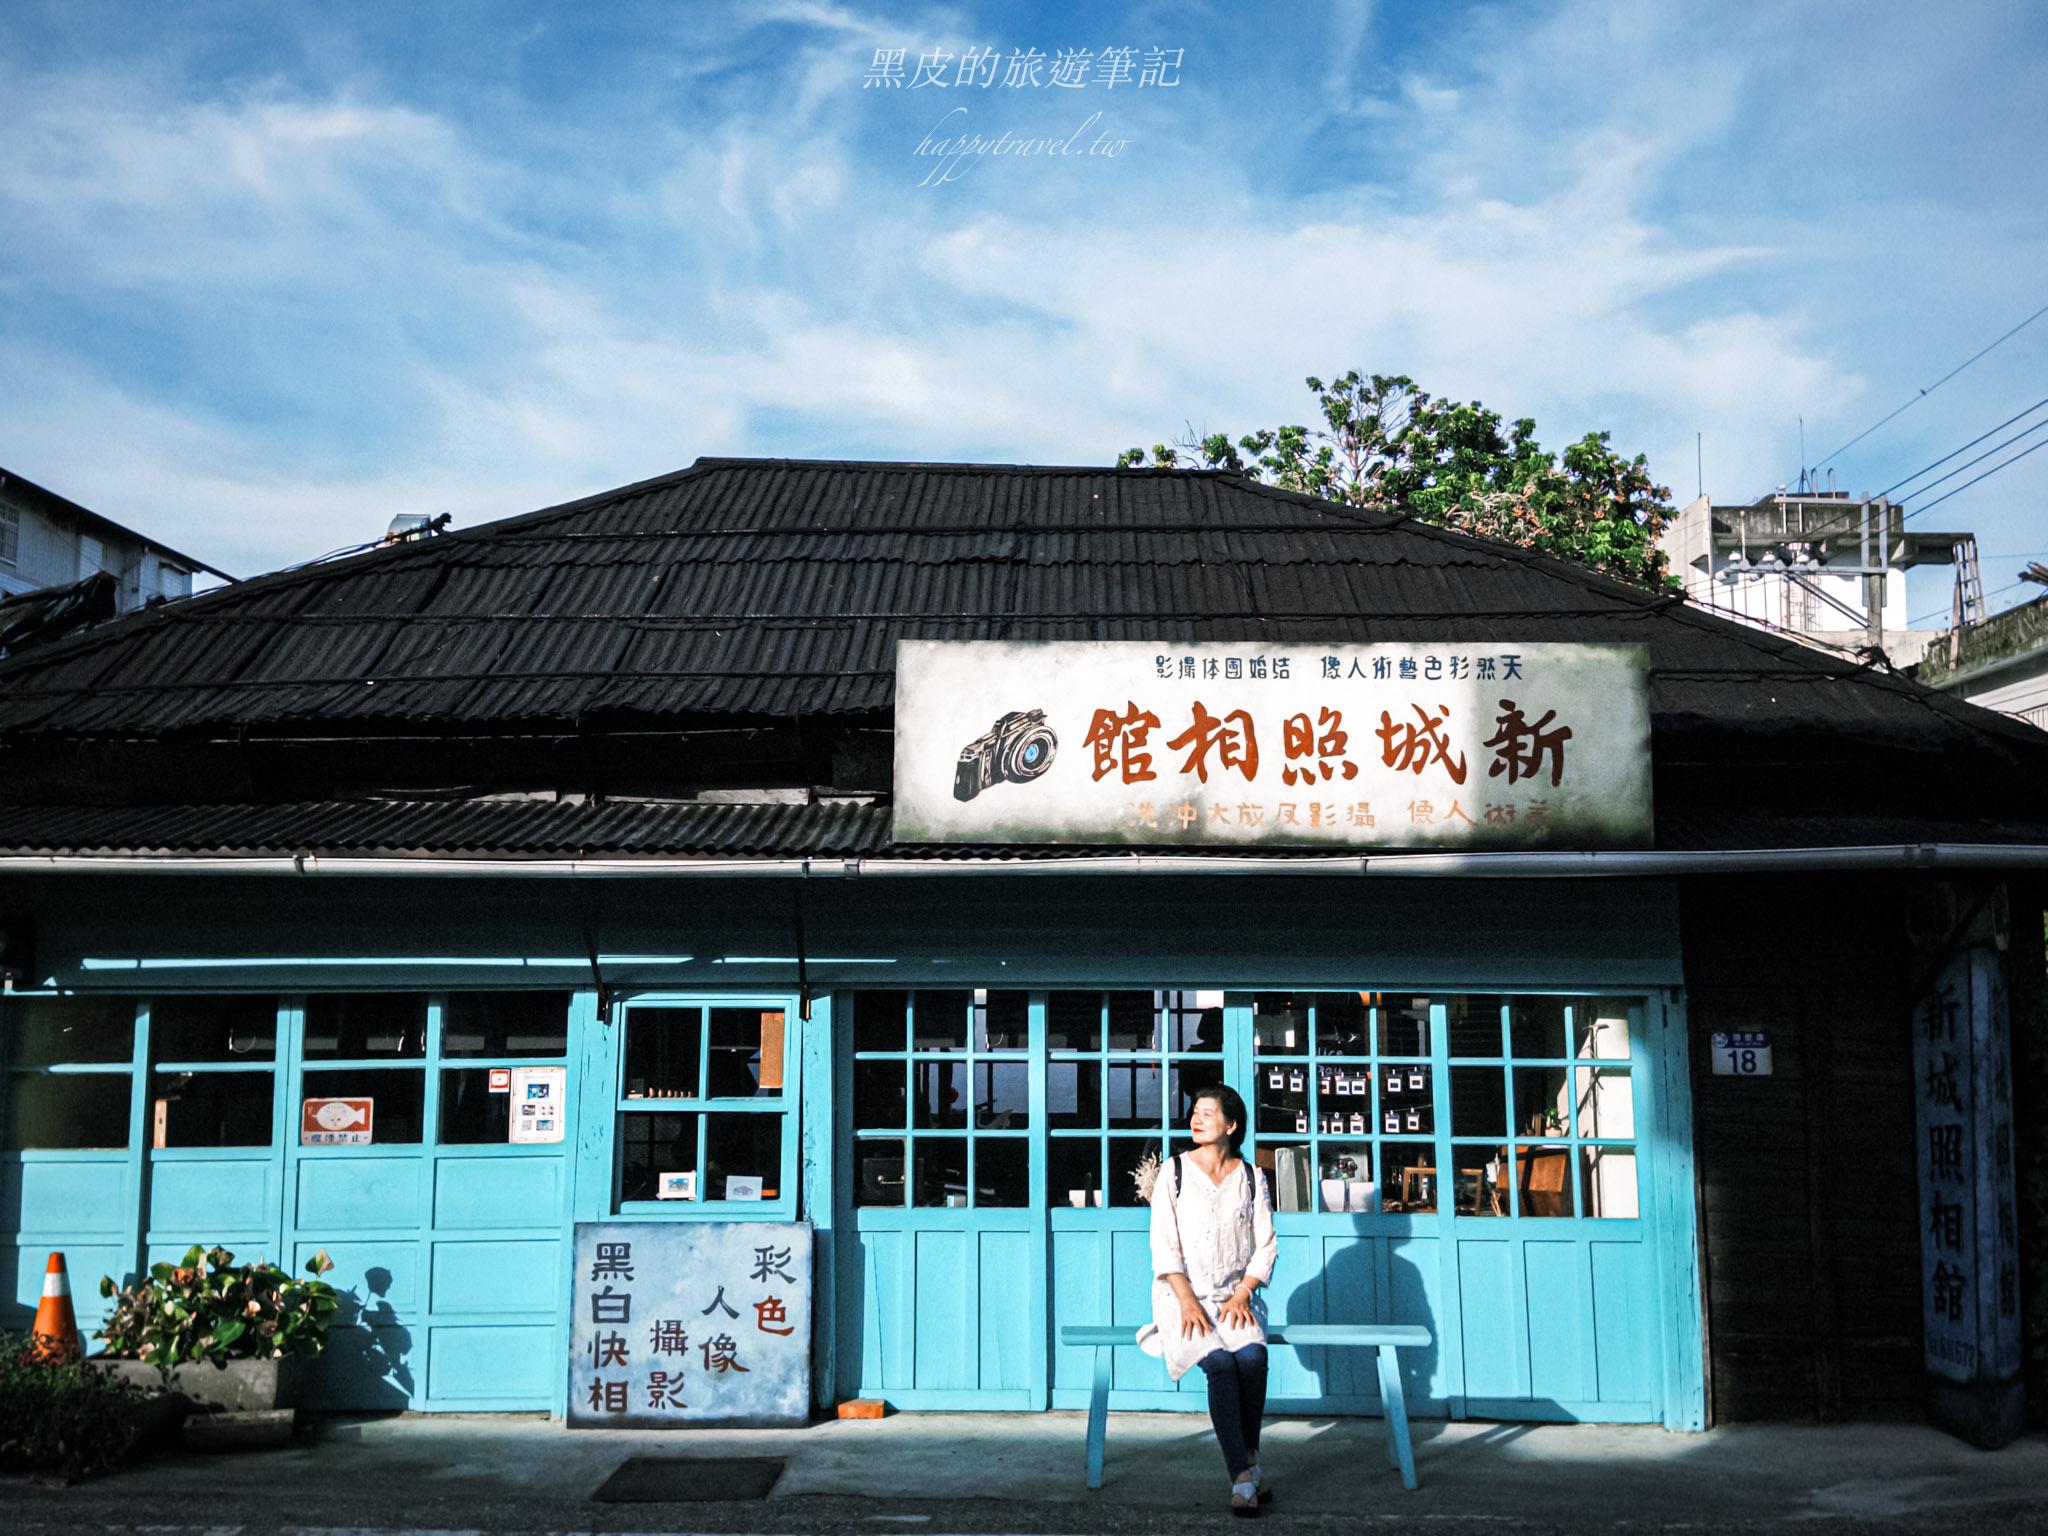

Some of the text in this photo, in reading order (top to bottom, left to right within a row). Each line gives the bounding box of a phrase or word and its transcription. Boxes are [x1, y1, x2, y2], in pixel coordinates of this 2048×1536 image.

[1081, 699, 1574, 787] 新城照相館
[1727, 1049, 1757, 1074] 18
[587, 1242, 635, 1413] 黑白快相
[698, 1285, 750, 1373] 人像
[750, 1245, 798, 1336] 彩色
[646, 1319, 690, 1410] 攝影
